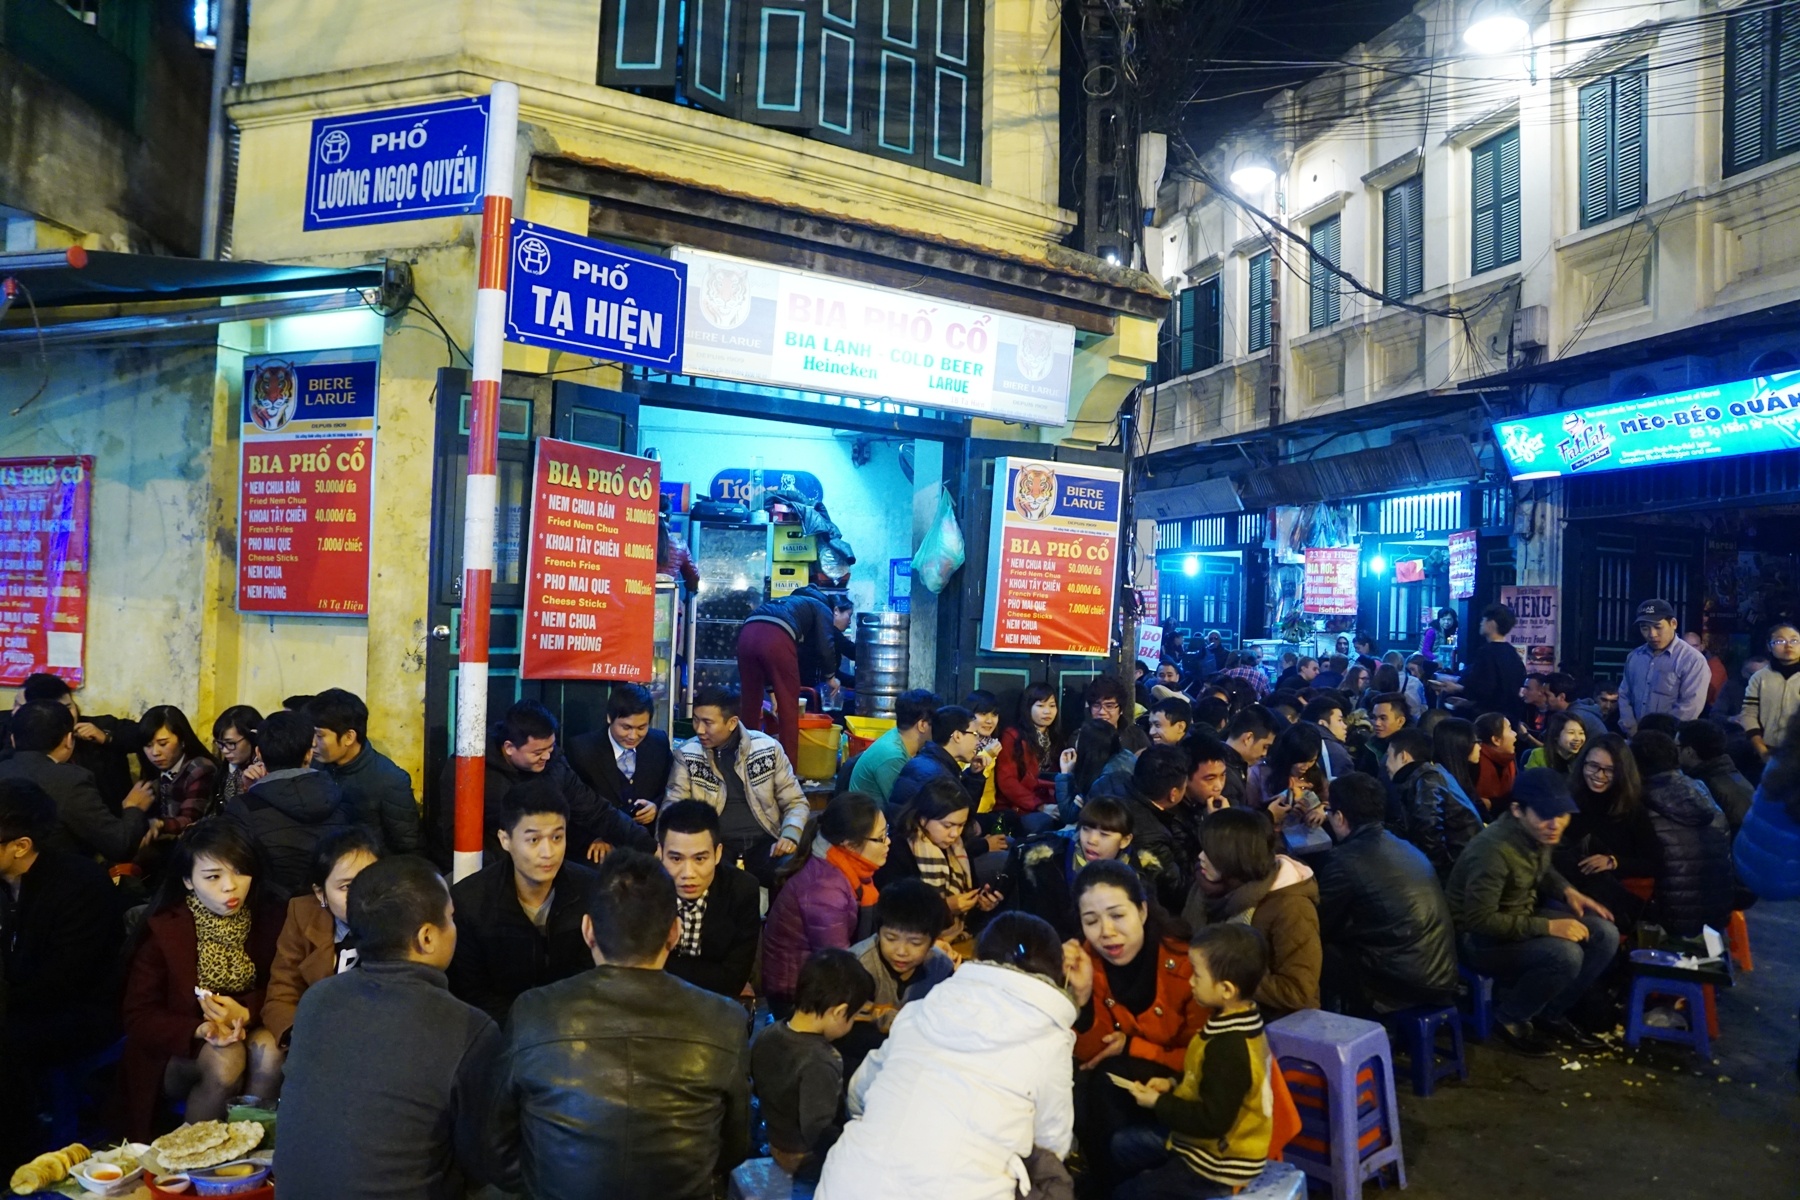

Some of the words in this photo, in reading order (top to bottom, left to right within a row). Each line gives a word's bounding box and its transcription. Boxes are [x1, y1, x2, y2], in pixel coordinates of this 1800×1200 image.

[371, 119, 429, 153] PHỐ
[318, 168, 370, 209] LƯƠNG
[373, 163, 418, 208] NGỌC
[421, 145, 477, 202] QUYẾN
[573, 259, 630, 290] PHỐ
[532, 285, 573, 336] TẠ
[585, 297, 662, 350] HIỆN
[788, 292, 848, 330] BIA
[864, 307, 939, 343] PHỐ
[945, 315, 992, 354] CỔ
[721, 334, 762, 348] LARUE
[785, 331, 817, 349] BIA
[823, 337, 872, 358] LẠNH
[890, 348, 934, 368] COLD
[940, 356, 984, 376] BEER
[803, 355, 878, 380] Heineken
[928, 374, 969, 393] LARUE
[309, 377, 353, 391] BIERE
[1003, 381, 1029, 393] BIERE
[305, 392, 356, 406] LARUE
[1620, 404, 1721, 433] MÈO-BÉO
[248, 455, 283, 474] BIA
[289, 444, 331, 472] PHỐ
[337, 440, 365, 472] CỔ
[249, 481, 264, 494] NEM
[266, 480, 284, 494] CHUA
[285, 477, 300, 493] RÁN
[547, 460, 583, 489] BIA
[587, 464, 626, 496] PHỐ
[628, 467, 653, 501] CỔ
[1066, 486, 1104, 499] BIERE
[548, 494, 570, 512] NEM
[572, 498, 595, 516] CHUA
[597, 500, 615, 519] RÁN
[1063, 497, 1105, 511] LARUE
[249, 510, 269, 522] KHOAI
[270, 506, 283, 522] TÂY
[285, 505, 307, 522] CHIÊN
[547, 516, 571, 527] Fried
[573, 520, 594, 530] Nem
[596, 523, 619, 534] Chua
[1415, 530, 1425, 539] 23
[248, 537, 262, 551] PHO
[263, 538, 276, 551] MAI
[277, 538, 291, 553] QUE
[545, 533, 574, 552] KHOAI
[576, 535, 592, 554] TÂY
[593, 539, 620, 558] CHIÊN
[1010, 538, 1042, 555] BIA
[1047, 538, 1083, 559] PHỐ
[1086, 538, 1110, 561] CỔ
[276, 554, 299, 562] Sticks
[544, 556, 577, 568] French
[579, 560, 601, 571] Fries
[1010, 558, 1024, 569] NEM
[1026, 559, 1041, 570] CHUA
[1043, 558, 1056, 571] RÁN
[247, 566, 262, 578] NEM
[264, 566, 282, 578] CHUA
[543, 573, 566, 590] PHO
[568, 576, 589, 592] MAI
[591, 578, 610, 595] QUE
[1009, 579, 1027, 589] KHOAI
[1029, 578, 1041, 590] TÂY
[1042, 580, 1060, 592] CHIÊN
[247, 586, 262, 598] NEM
[1032, 591, 1049, 599] Fries
[318, 599, 328, 608] 18
[330, 600, 340, 611] Tạ
[343, 600, 364, 612] Hiện
[542, 595, 576, 606] Cheese
[578, 598, 607, 608] Sticks
[1007, 599, 1021, 609] PHO
[1022, 600, 1034, 610] MAI
[1034, 600, 1047, 612] QUE
[541, 611, 566, 628] NEM
[569, 613, 596, 630] CHUA
[1006, 619, 1020, 629] NEM
[1021, 620, 1038, 630] CHUA
[540, 634, 564, 650] NEM
[567, 633, 602, 652] PHÙNG
[1005, 633, 1019, 644] NEM
[1138, 646, 1160, 659] BÍA
[591, 663, 602, 674] 18
[604, 663, 616, 676] Tạ
[619, 664, 640, 677] Hiện
